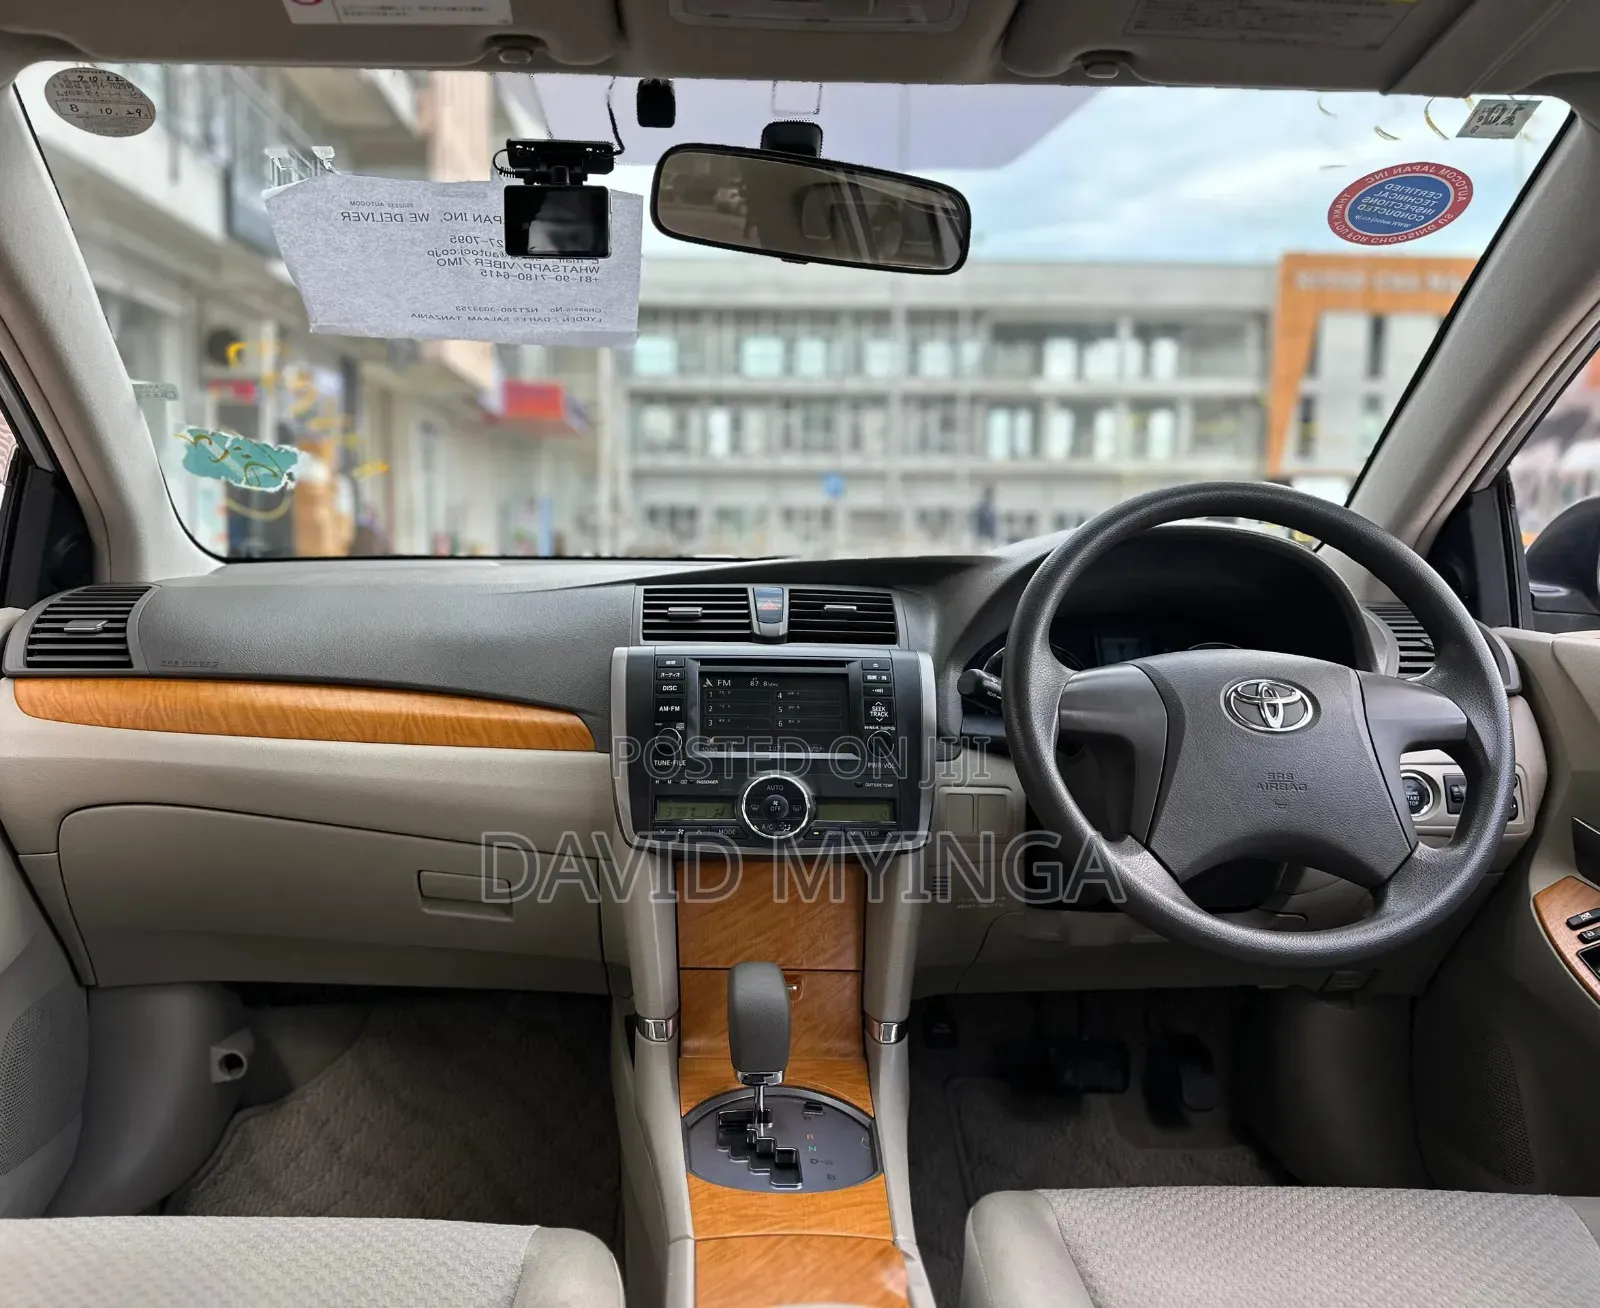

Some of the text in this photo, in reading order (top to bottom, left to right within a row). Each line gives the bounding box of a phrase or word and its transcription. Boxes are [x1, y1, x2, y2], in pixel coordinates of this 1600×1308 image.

[717, 679, 731, 687] FM
[1267, 772, 1294, 780] SRS
[1257, 782, 1307, 791] AIRBAG
